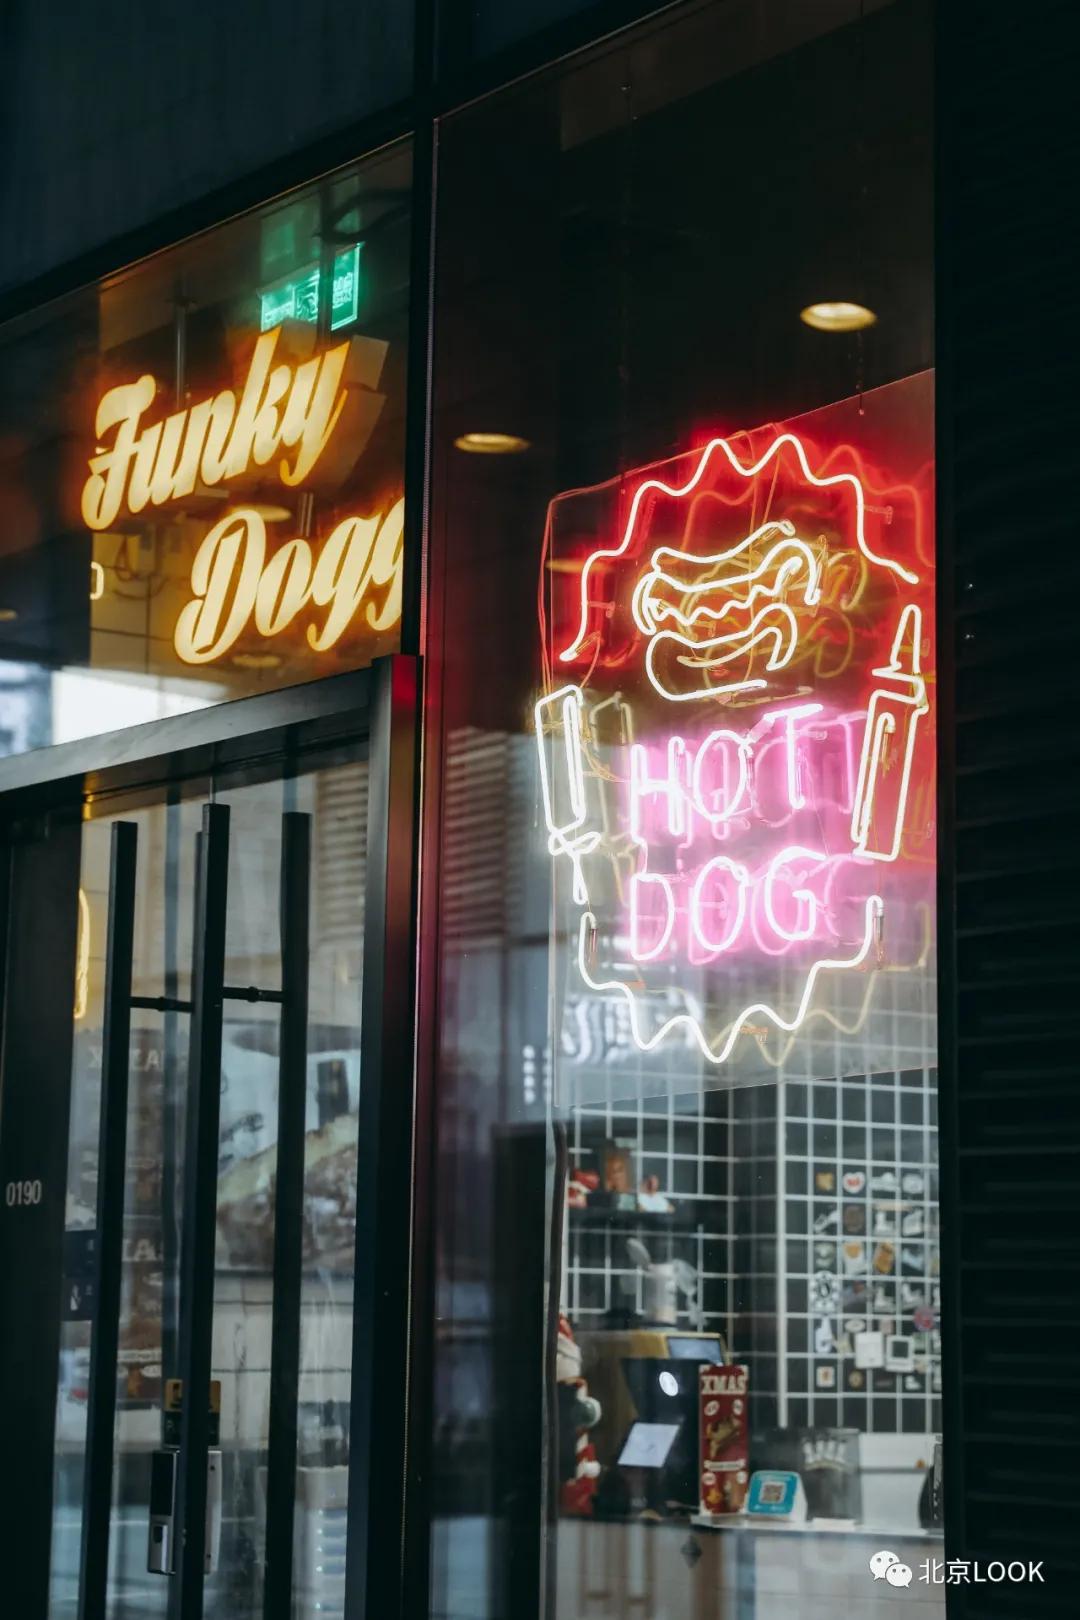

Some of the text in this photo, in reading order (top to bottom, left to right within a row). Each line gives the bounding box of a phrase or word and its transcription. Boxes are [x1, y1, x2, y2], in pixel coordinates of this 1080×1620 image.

[81, 325, 350, 530] Funky
[631, 703, 824, 836] HOT
[631, 845, 829, 961] DOG
[6, 1180, 42, 1206] 0190
[701, 1375, 747, 1395] XMAS
